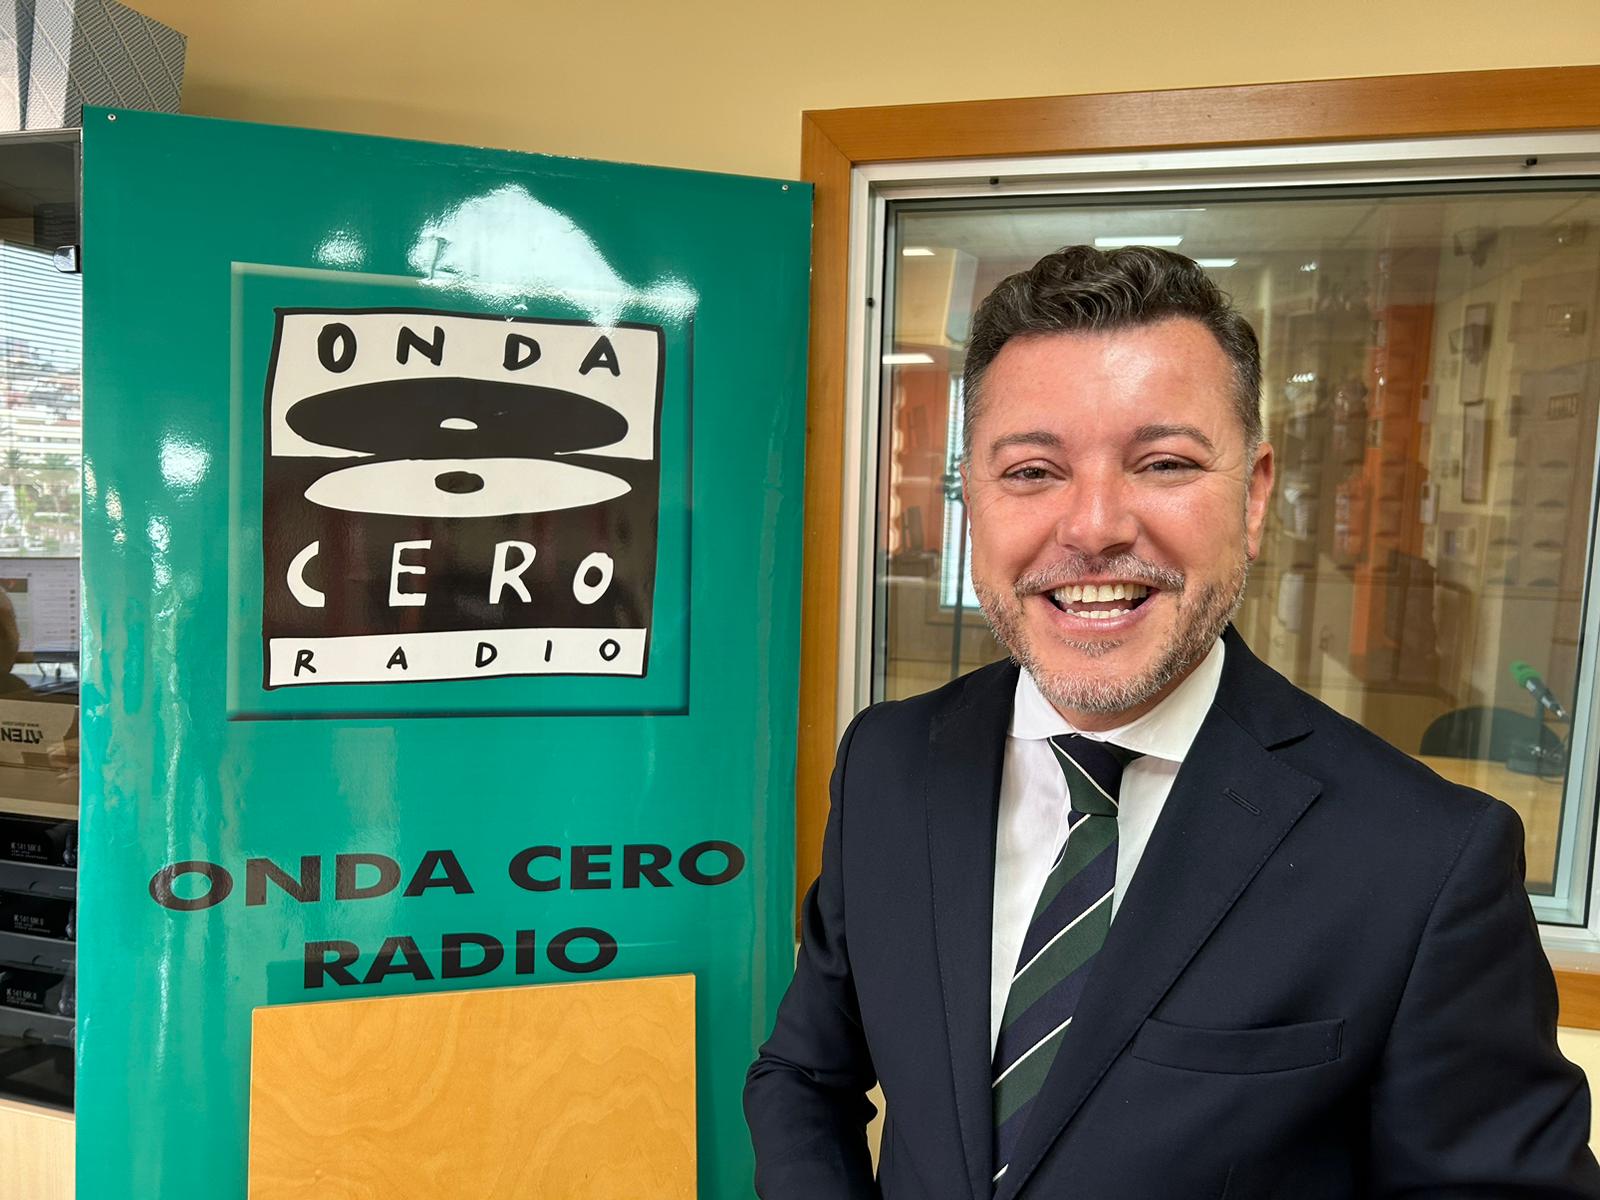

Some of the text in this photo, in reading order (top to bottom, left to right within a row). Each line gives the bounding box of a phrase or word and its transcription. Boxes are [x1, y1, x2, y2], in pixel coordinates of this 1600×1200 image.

[316, 322, 621, 377] ONDA
[286, 539, 615, 608] CERO
[294, 638, 621, 677] RADIO
[1, 727, 44, 744] ATEN
[148, 840, 746, 911] ONDA CERO
[303, 926, 619, 989] RADIO
